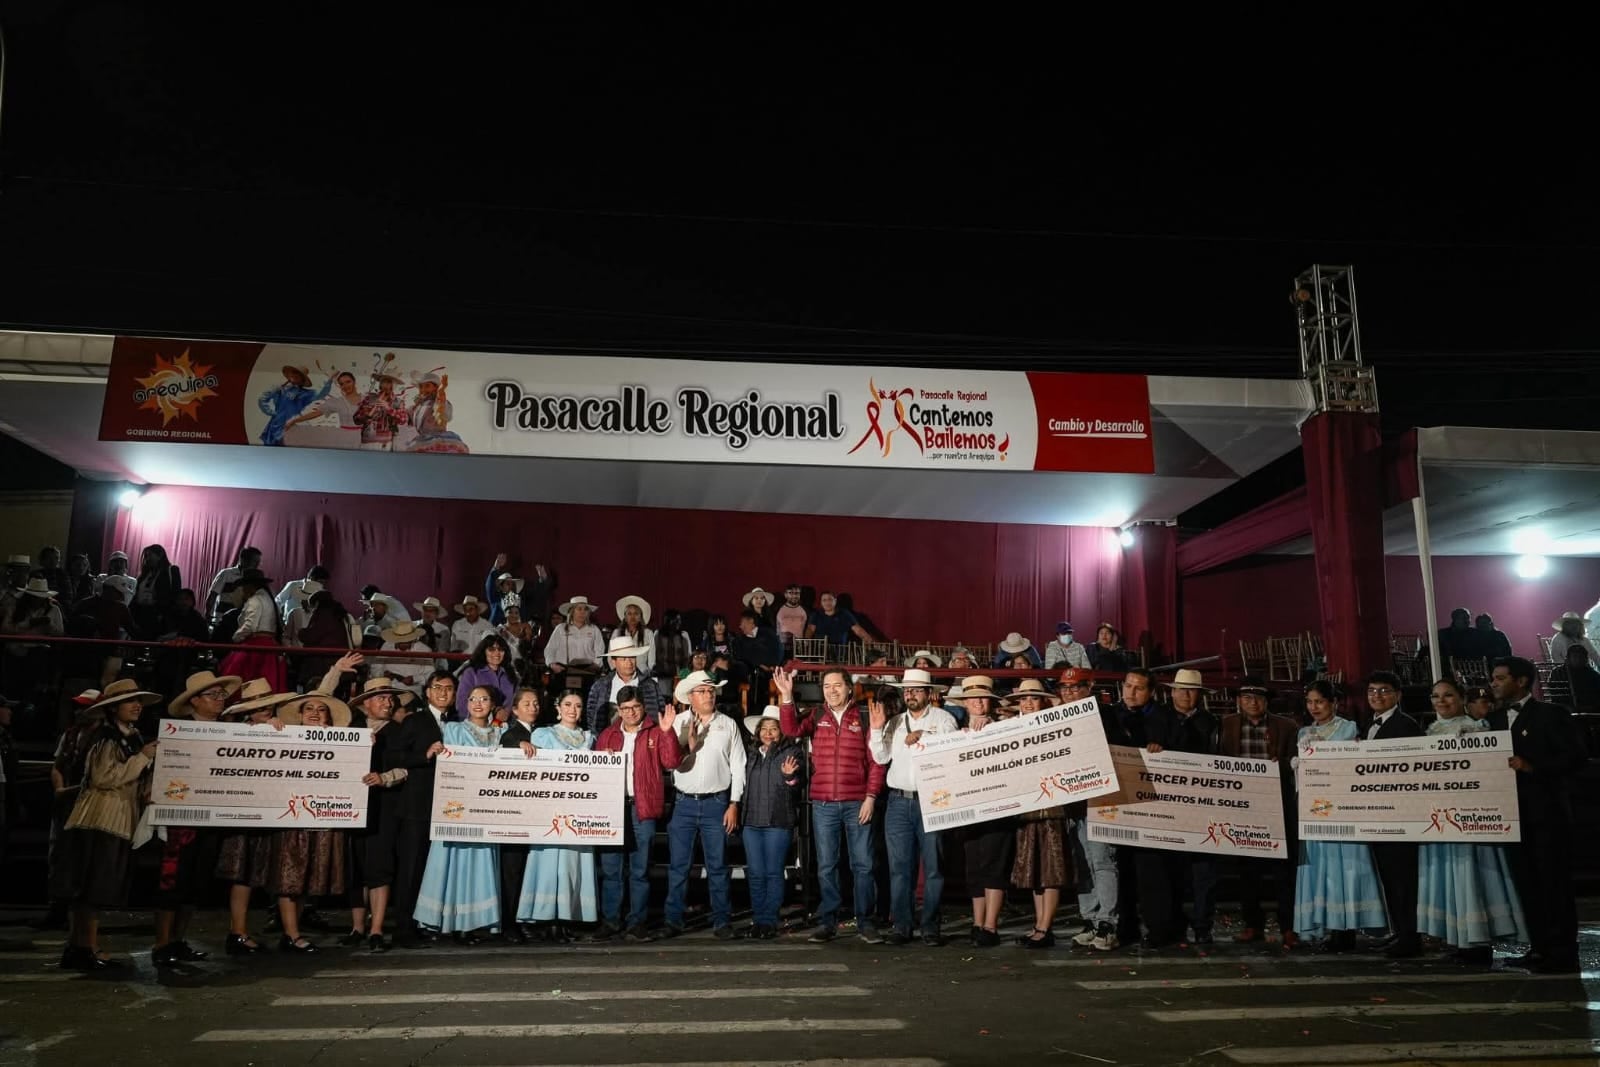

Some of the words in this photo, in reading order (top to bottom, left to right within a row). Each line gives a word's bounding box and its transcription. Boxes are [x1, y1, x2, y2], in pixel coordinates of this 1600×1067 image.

[920, 389, 953, 400] Pasacalle
[957, 391, 987, 403] Regional
[487, 382, 672, 432] Pasacalle
[678, 389, 844, 448] Regional
[910, 404, 993, 427] Cantemos
[1048, 418, 1085, 431] Cambio
[1087, 421, 1093, 433] y
[1095, 419, 1144, 433] Desarrollo
[126, 429, 168, 437] GOBIERNO
[171, 430, 211, 439] REGIONAL
[1034, 701, 1094, 725] 1'000,000.00
[305, 730, 360, 742] 300,000.00
[959, 740, 1019, 762] SEGUNDO
[1023, 727, 1072, 747] PUESTO
[1437, 736, 1497, 751] 200,000.00
[216, 747, 276, 759] CUARTO
[280, 749, 334, 760] PUESTO
[564, 754, 622, 766] 2'000,000.00
[970, 768, 984, 777] UN
[986, 757, 1022, 774] MILLÓN
[1025, 755, 1038, 765] DE
[1040, 747, 1071, 761] SOLES
[1214, 760, 1267, 773] 500,000.00
[1355, 763, 1409, 775] QUINTO
[1413, 760, 1471, 772] PUESTO
[209, 768, 283, 778] TRESCIENTOS
[285, 770, 304, 778] MIL
[306, 771, 340, 779] SOLES
[488, 770, 537, 780] PRIMER
[540, 772, 590, 782] PUESTO
[1060, 771, 1100, 785] Cantemos
[1138, 771, 1187, 785] TERCER
[1191, 777, 1243, 790] PUESTO
[1350, 783, 1419, 792] DOSCIENTOS
[1422, 782, 1441, 791] MIL
[1443, 781, 1480, 790] SOLES
[478, 789, 500, 797] DOS
[501, 790, 550, 798] MILLONES
[552, 791, 566, 799] DE
[1136, 791, 1196, 804] QUINIENTOS
[1198, 797, 1215, 805] MIL
[1217, 799, 1249, 808] SOLES
[310, 801, 352, 809] Cantemos
[572, 819, 610, 828] Cantemos
[1454, 813, 1502, 823] Cantemos
[1229, 829, 1270, 839] Cantemos
